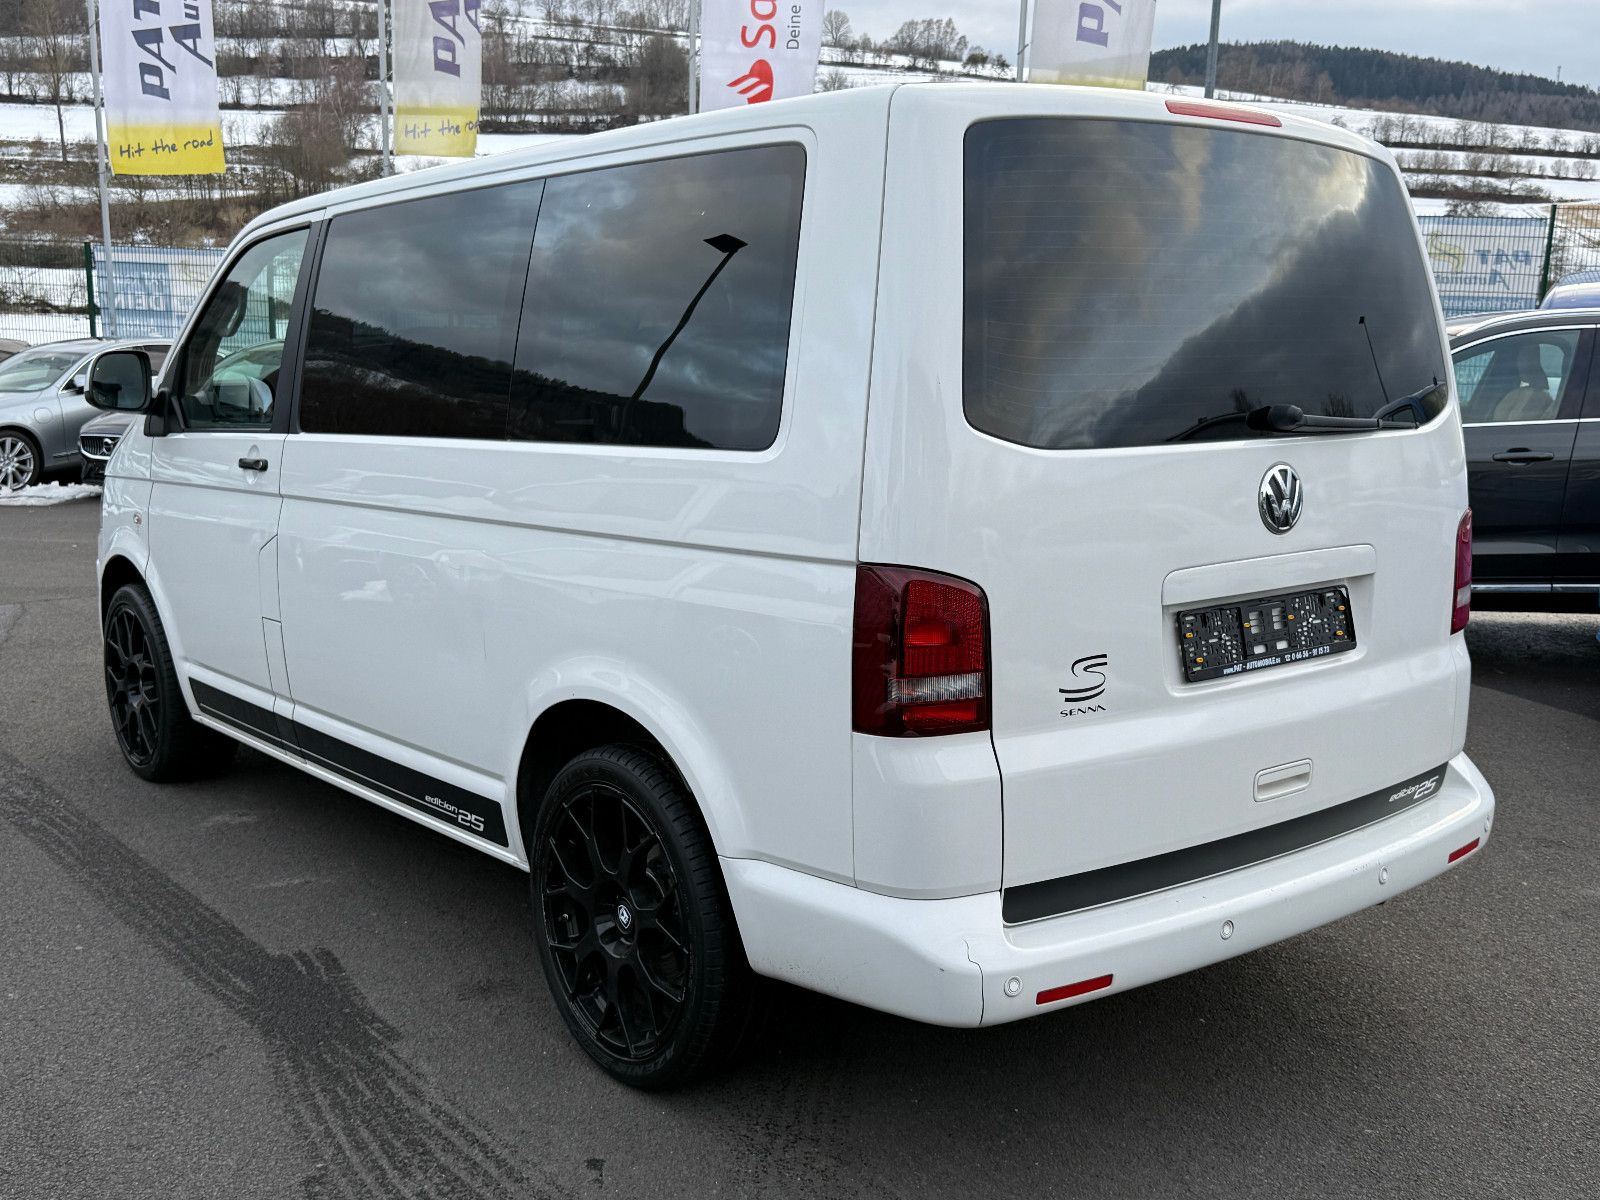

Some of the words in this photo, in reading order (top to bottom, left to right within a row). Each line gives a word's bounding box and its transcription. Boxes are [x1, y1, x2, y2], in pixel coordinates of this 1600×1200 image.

[741, 0, 777, 49] Sa
[786, 5, 801, 49] Deine
[120, 142, 145, 159] Hit
[151, 138, 178, 155] the
[184, 129, 213, 151] road
[405, 122, 431, 139] Hit
[438, 119, 461, 136] the
[1060, 704, 1107, 718] SENNA
[1388, 784, 1420, 802] edition
[1413, 775, 1439, 799] 25
[425, 794, 458, 814] edition
[458, 809, 485, 832] 25
